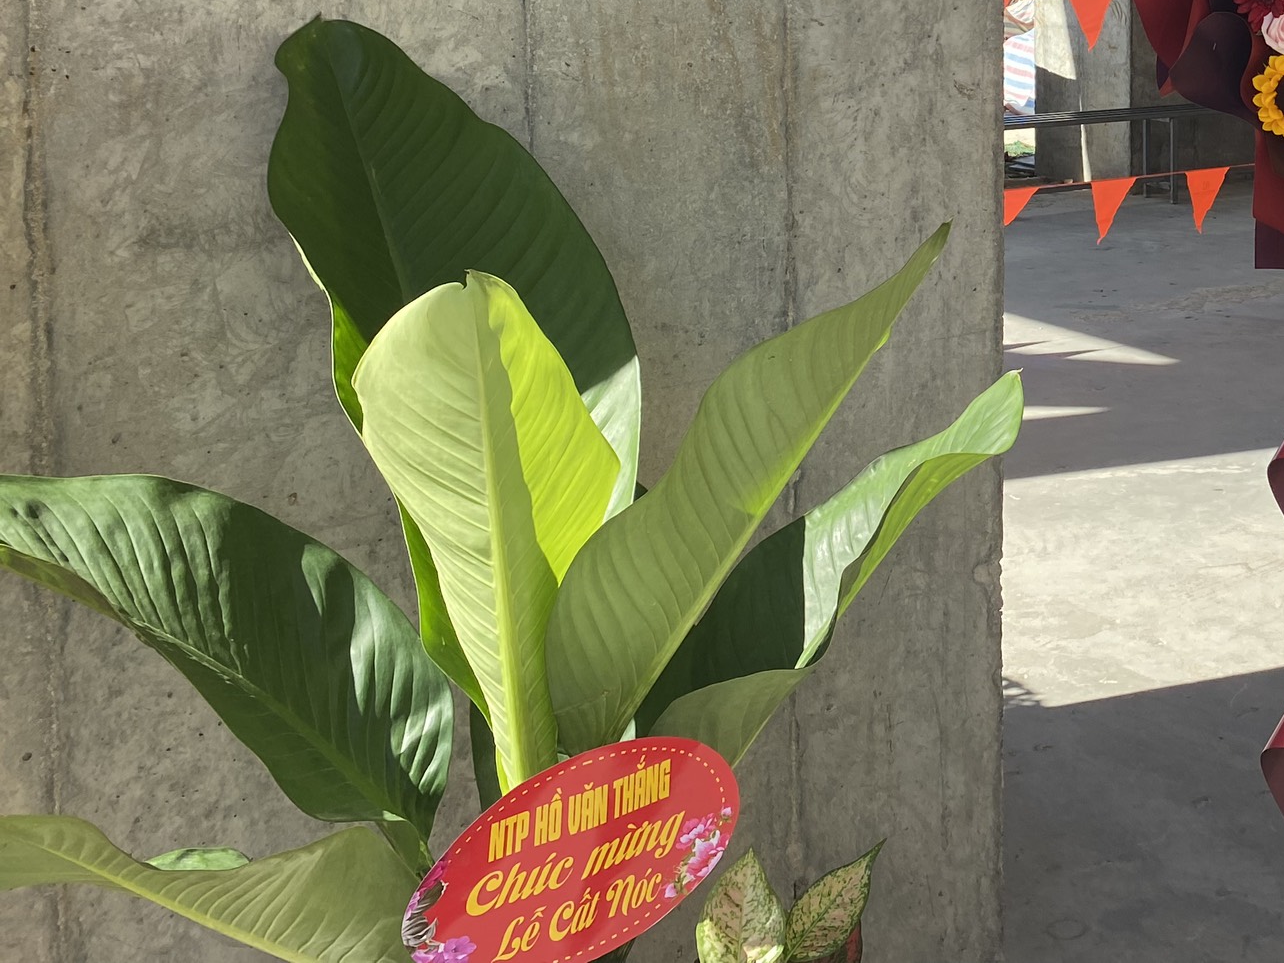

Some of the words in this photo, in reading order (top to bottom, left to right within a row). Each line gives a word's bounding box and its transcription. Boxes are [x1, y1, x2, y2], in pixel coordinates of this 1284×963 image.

[487, 807, 530, 863] NTP
[533, 789, 563, 847] HỒ
[568, 782, 609, 836] VĂN
[612, 754, 672, 817] THẮNG
[465, 852, 575, 917] Chúc
[580, 809, 686, 881] mừng
[490, 905, 548, 963] Lễ
[548, 886, 602, 942] Cất
[605, 867, 664, 919] Nóc
